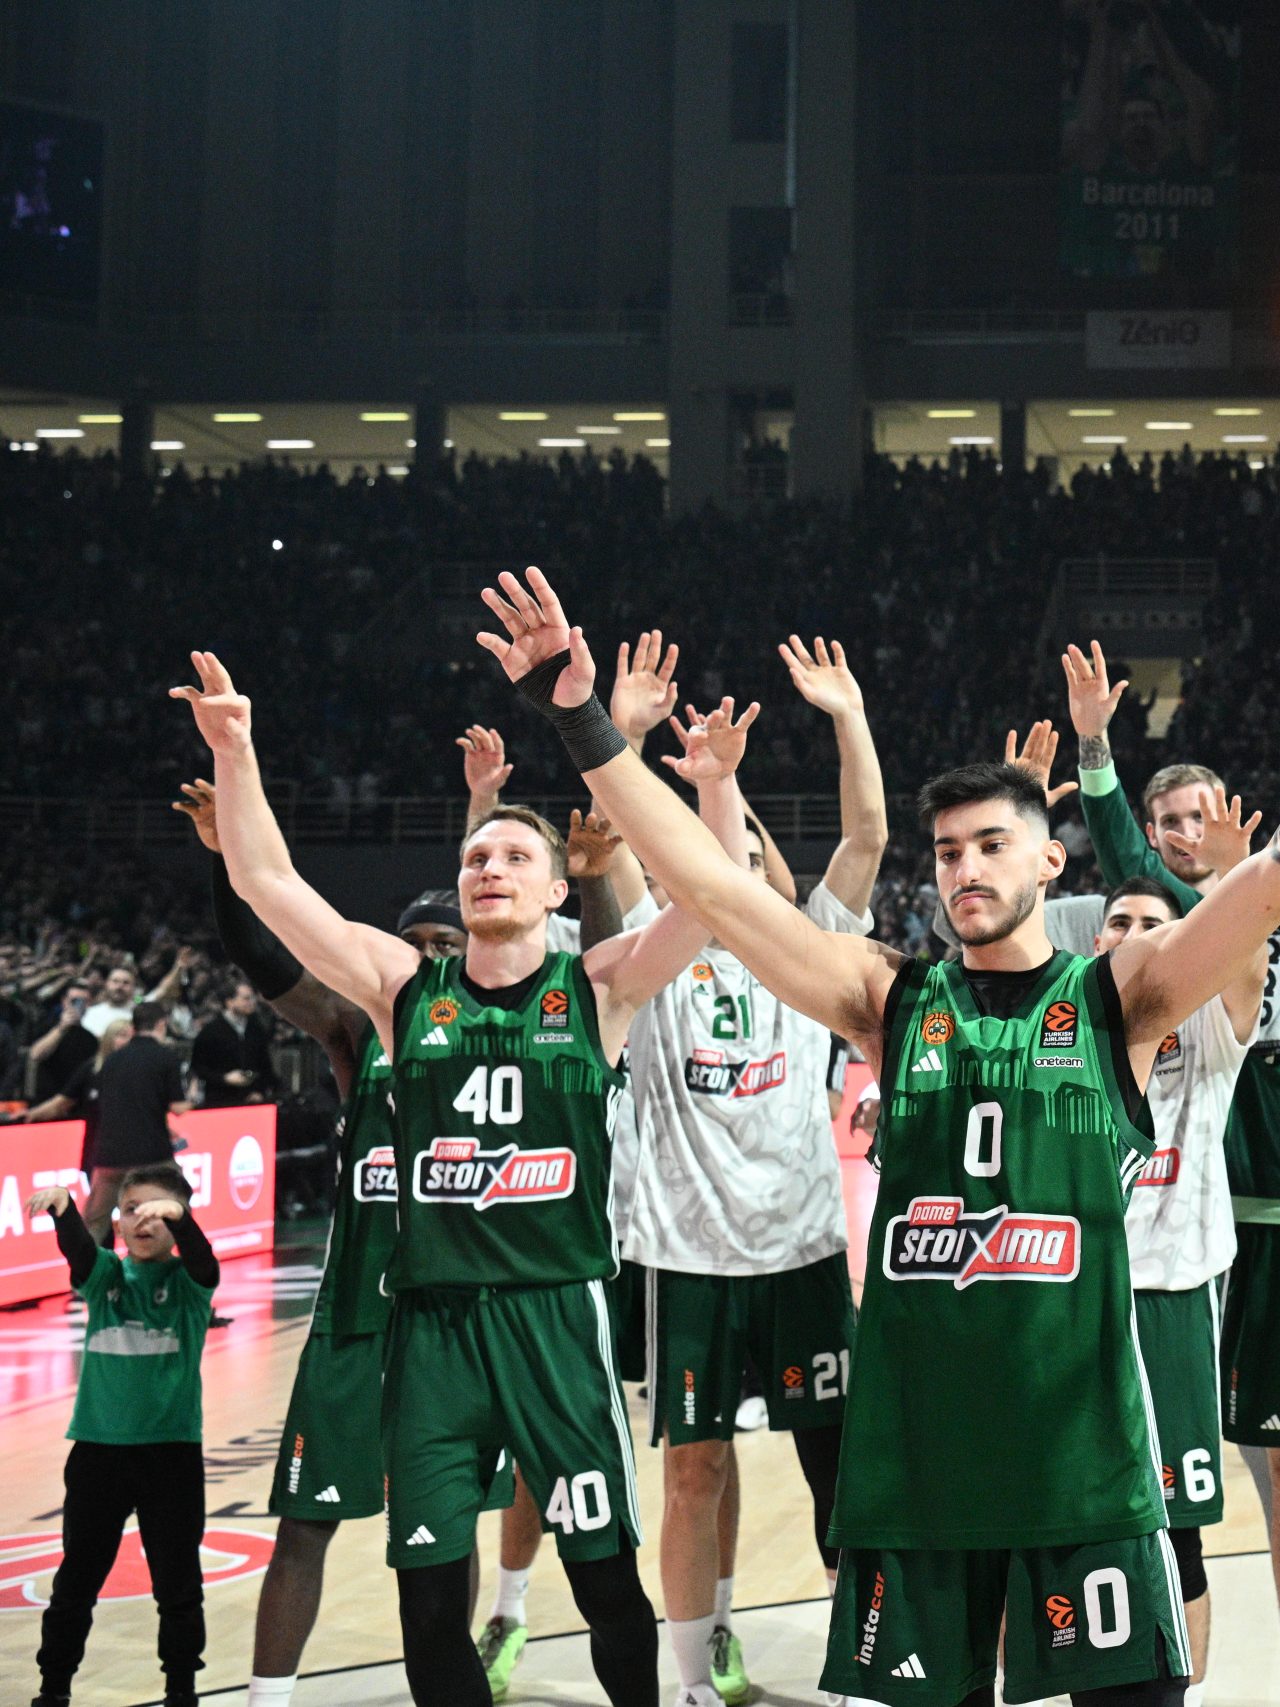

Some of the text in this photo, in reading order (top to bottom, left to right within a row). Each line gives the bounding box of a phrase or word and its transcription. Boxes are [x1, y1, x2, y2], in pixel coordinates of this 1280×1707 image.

[1082, 177, 1214, 206] Barcelona
[1115, 212, 1179, 239] 2011
[711, 994, 752, 1040] 21
[1035, 1056, 1083, 1067] oneteam
[453, 1066, 523, 1125] 40
[963, 1101, 1003, 1178] 0
[912, 1205, 955, 1224] pame
[811, 1348, 850, 1401] 21
[287, 1433, 305, 1494] instacar
[1182, 1447, 1216, 1503] 6
[545, 1469, 612, 1535] 40
[853, 1570, 886, 1666] instacar
[1053, 1626, 1076, 1637] TURKISH
[1082, 1566, 1132, 1649] 0
[1053, 1632, 1076, 1642] AIRLINES
